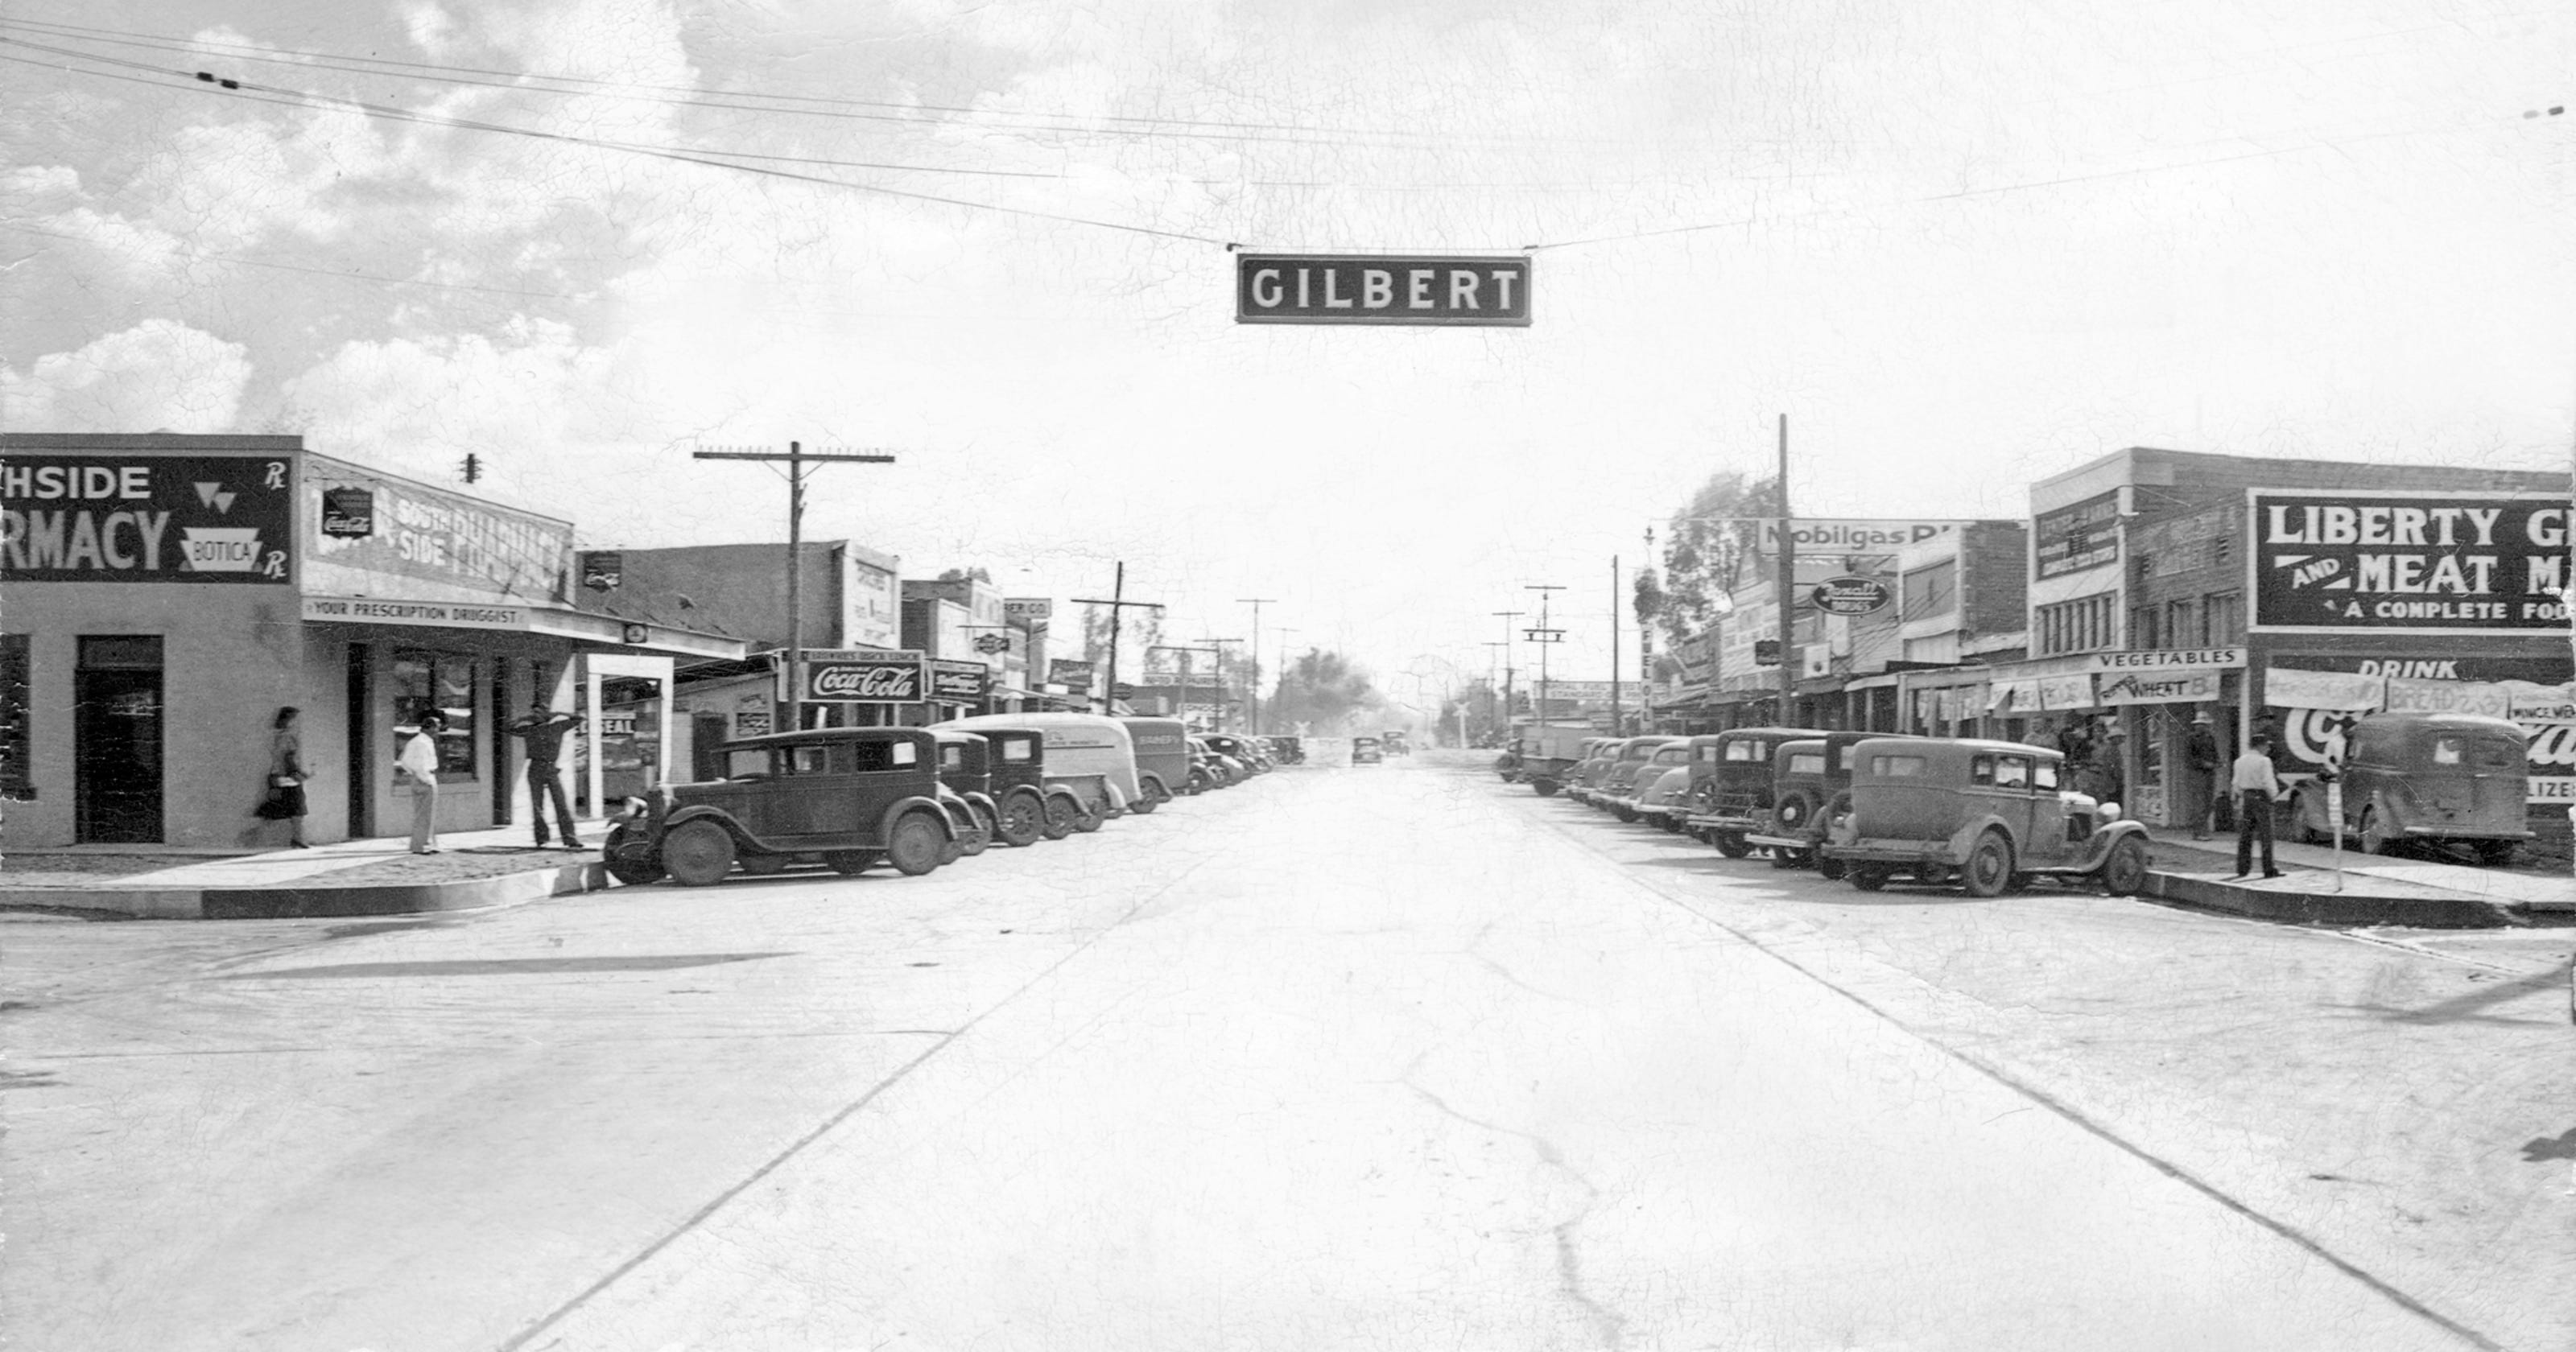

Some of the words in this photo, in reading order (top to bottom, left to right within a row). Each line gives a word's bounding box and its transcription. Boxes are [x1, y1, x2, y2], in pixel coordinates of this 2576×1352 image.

[1252, 268, 1518, 310] GILBERT
[2265, 505, 2503, 546] LIBERTY
[193, 541, 253, 562] BOTICA
[399, 530, 447, 566] SIDE
[2293, 559, 2341, 590] AND
[2355, 554, 2498, 595] MEAT
[1820, 582, 1879, 602] Rexall
[314, 601, 349, 616] YOUR
[353, 603, 447, 620] PRESCRIPTION
[452, 608, 518, 624] DRUGGIST
[2343, 601, 2364, 619] A
[2375, 601, 2508, 619] COMPLETE
[2099, 649, 2236, 668] VEGETABLES
[2358, 660, 2458, 679] DRINK
[813, 666, 919, 697] Coca-Cola
[1642, 685, 1652, 722] OIL
[2390, 686, 2454, 711] BREAD
